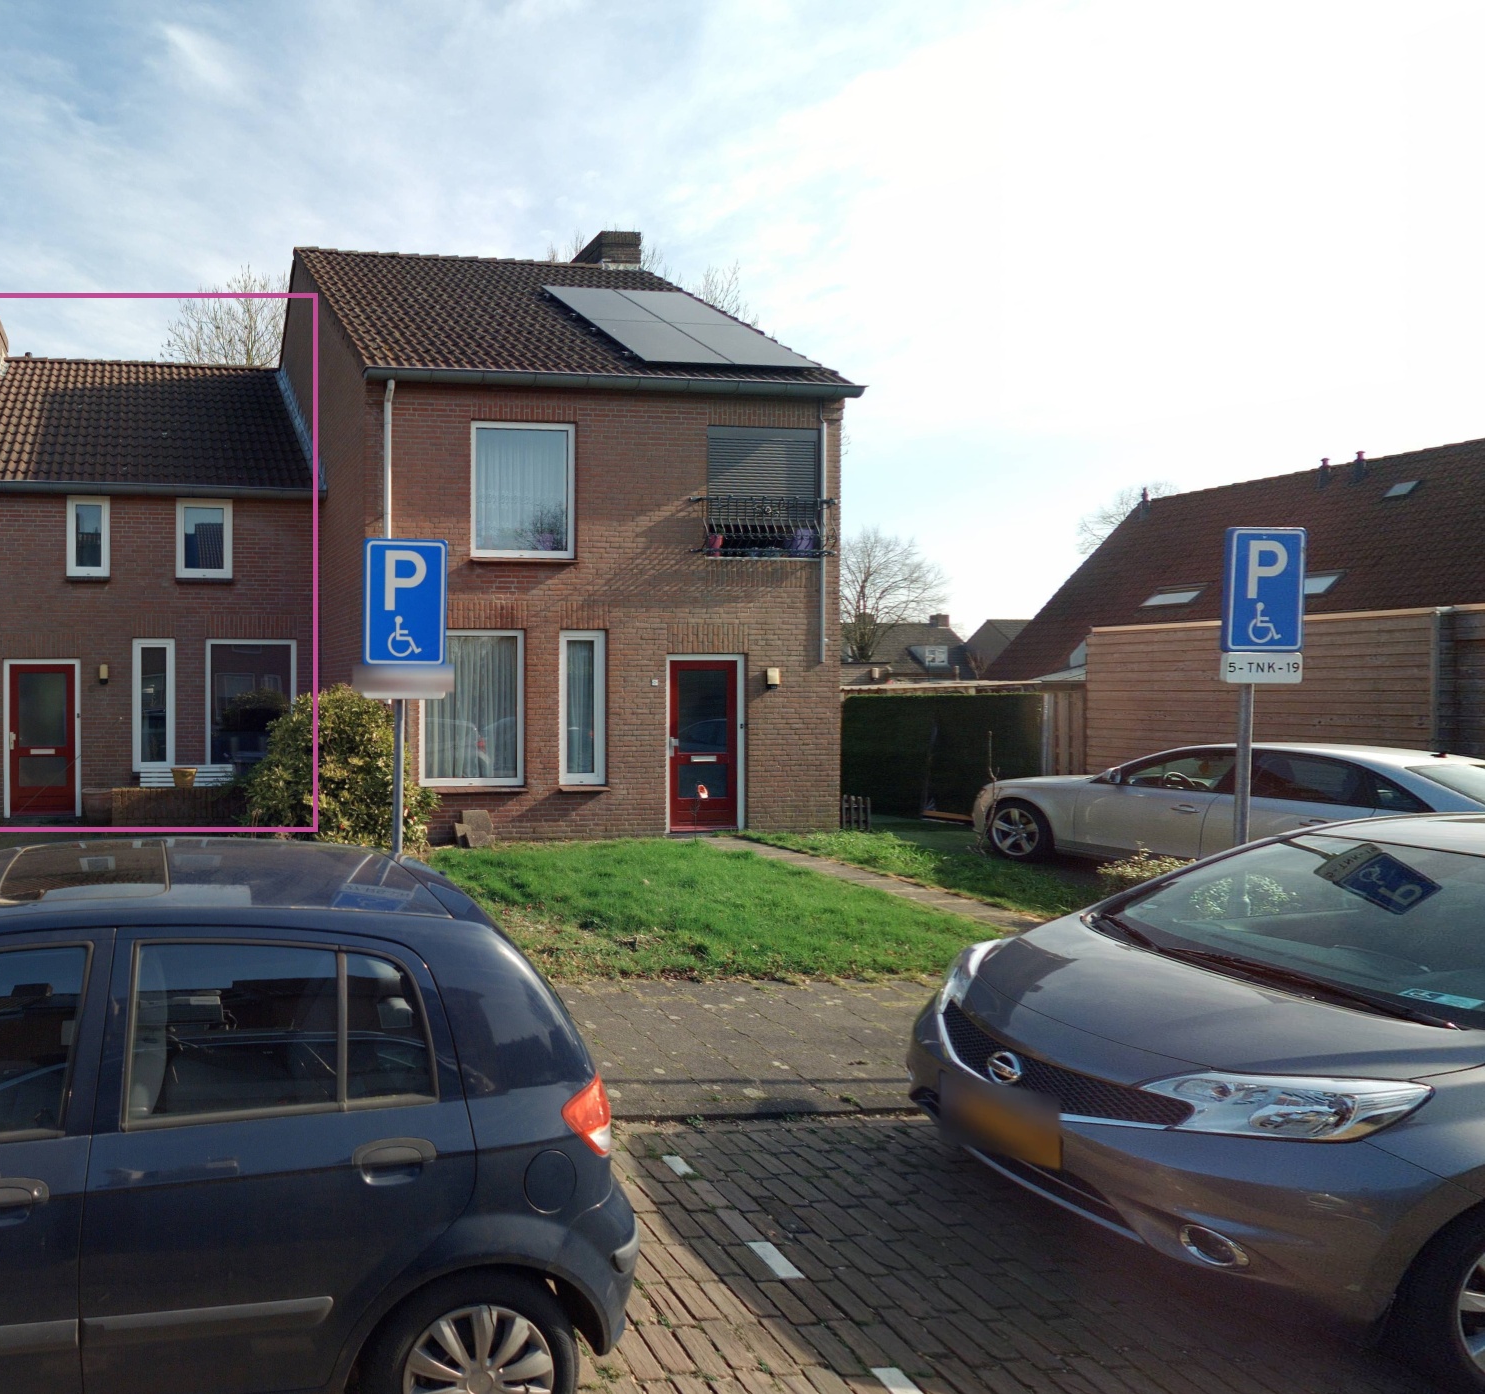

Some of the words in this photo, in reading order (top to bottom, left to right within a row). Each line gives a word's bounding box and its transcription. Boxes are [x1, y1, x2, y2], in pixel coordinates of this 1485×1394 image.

[384, 549, 427, 611] P
[1246, 540, 1289, 599] P
[1228, 661, 1301, 674] 5-TNK-19
